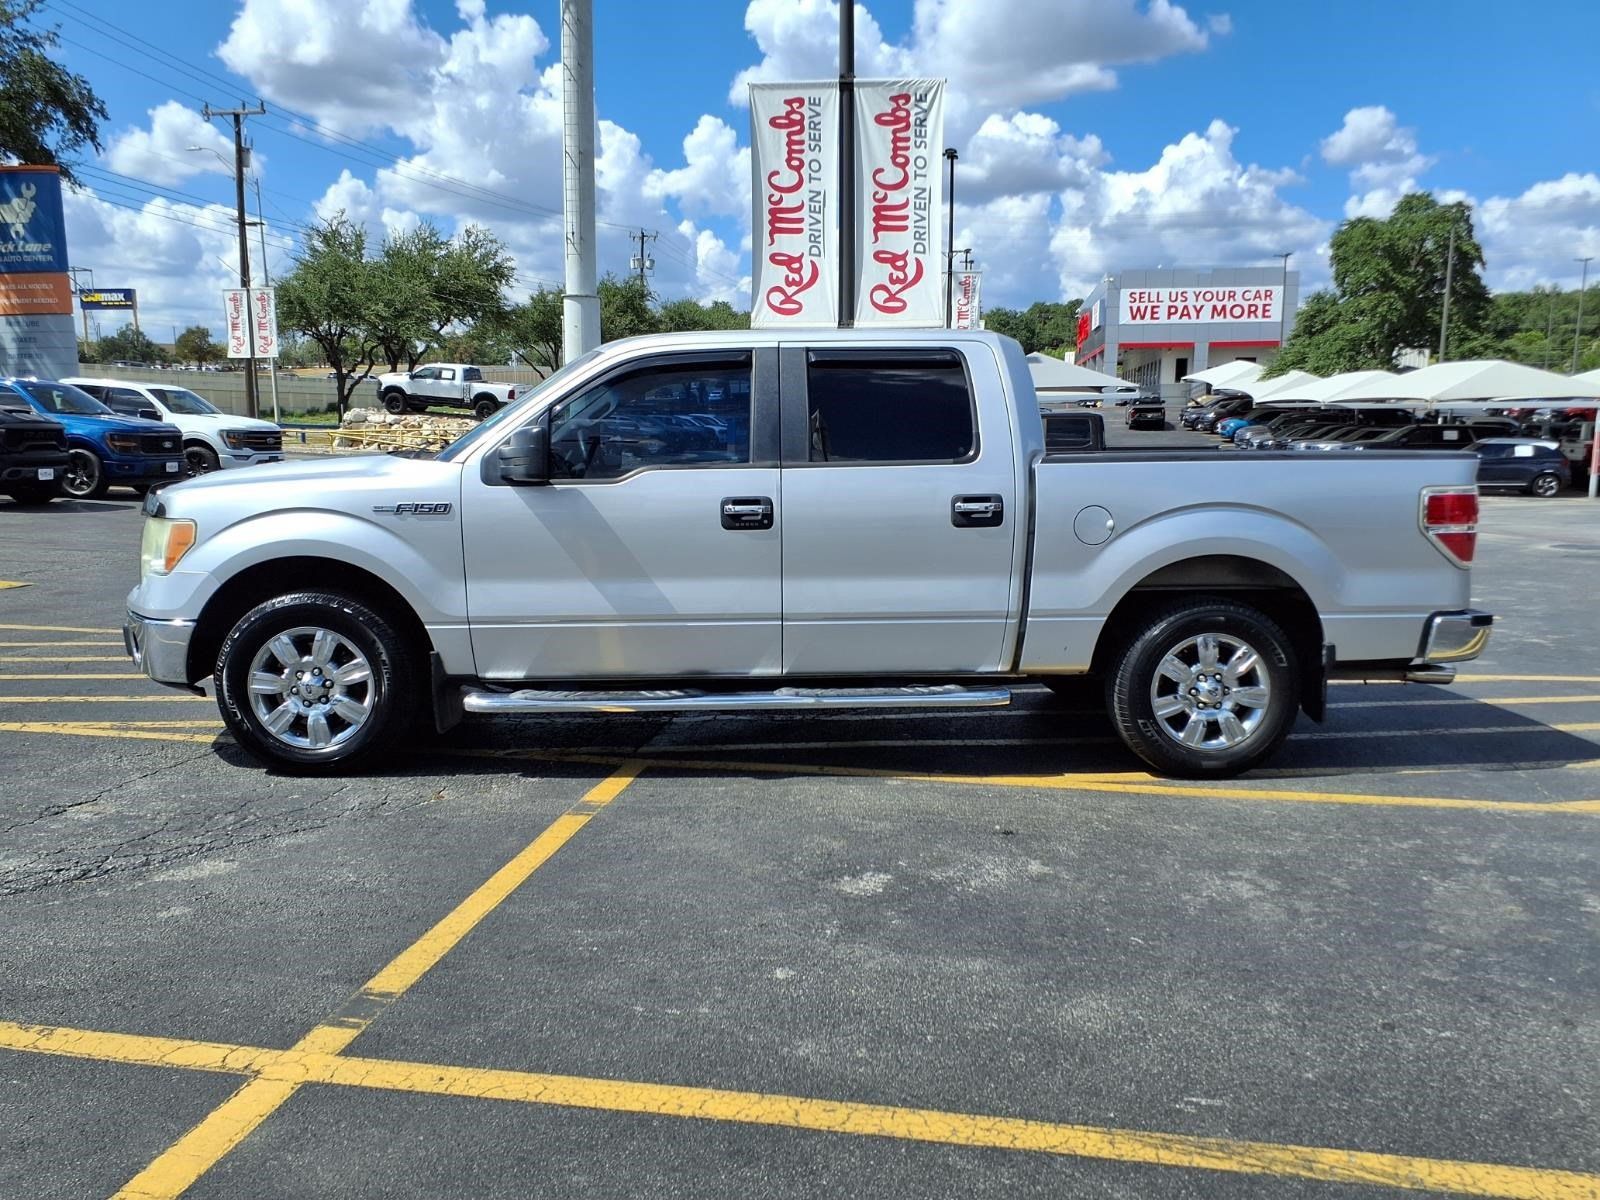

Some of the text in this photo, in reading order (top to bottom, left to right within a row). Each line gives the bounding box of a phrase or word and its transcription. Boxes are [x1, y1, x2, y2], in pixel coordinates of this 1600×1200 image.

[17, 240, 52, 252] Lane
[766, 96, 819, 316] Red McCombs
[808, 96, 822, 258] DRIVEN TO SERVE
[869, 92, 924, 314] Red McCombs
[913, 92, 928, 255] DRIVEN TO SERVE
[1129, 289, 1273, 304] SELL US YOUR CAR
[1129, 303, 1272, 321] WE PAY MORE
